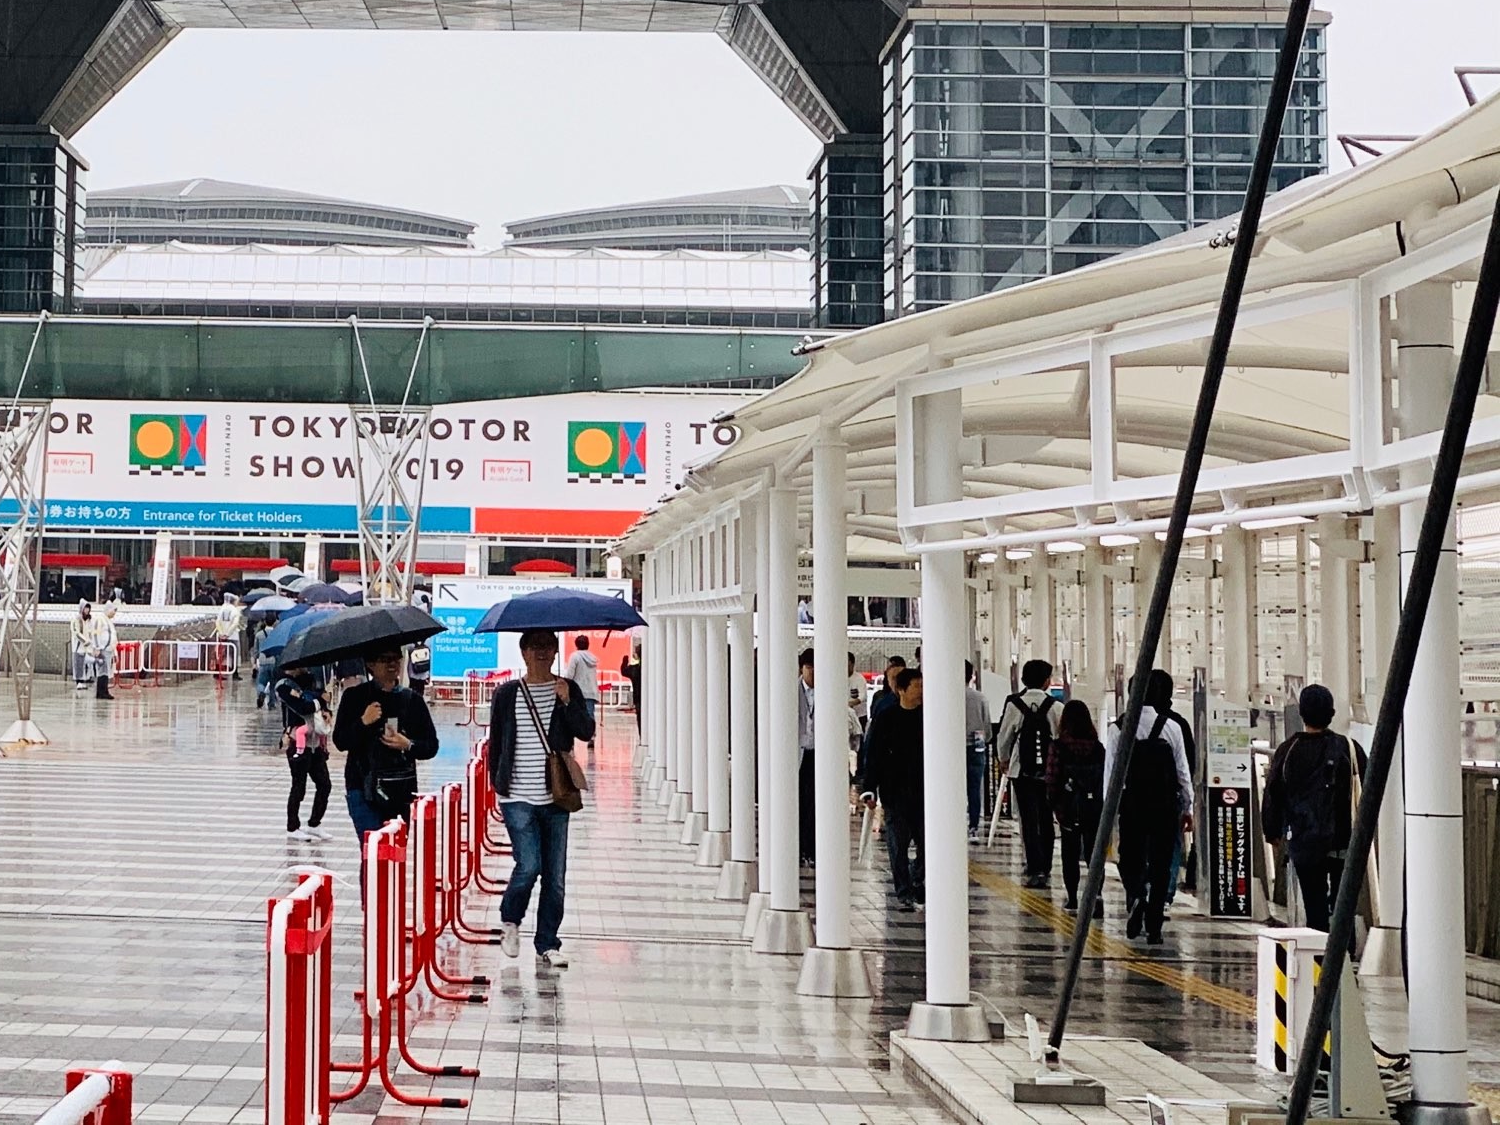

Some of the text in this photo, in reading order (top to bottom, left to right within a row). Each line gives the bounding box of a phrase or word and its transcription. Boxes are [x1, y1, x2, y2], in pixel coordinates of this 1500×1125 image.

[249, 415, 377, 439] TOKYO
[249, 455, 364, 479] SHOW
[143, 509, 303, 523] Entrance for Ticket Holders
[435, 636, 485, 644] Entrance for
[436, 644, 493, 653] Ticket Holders
